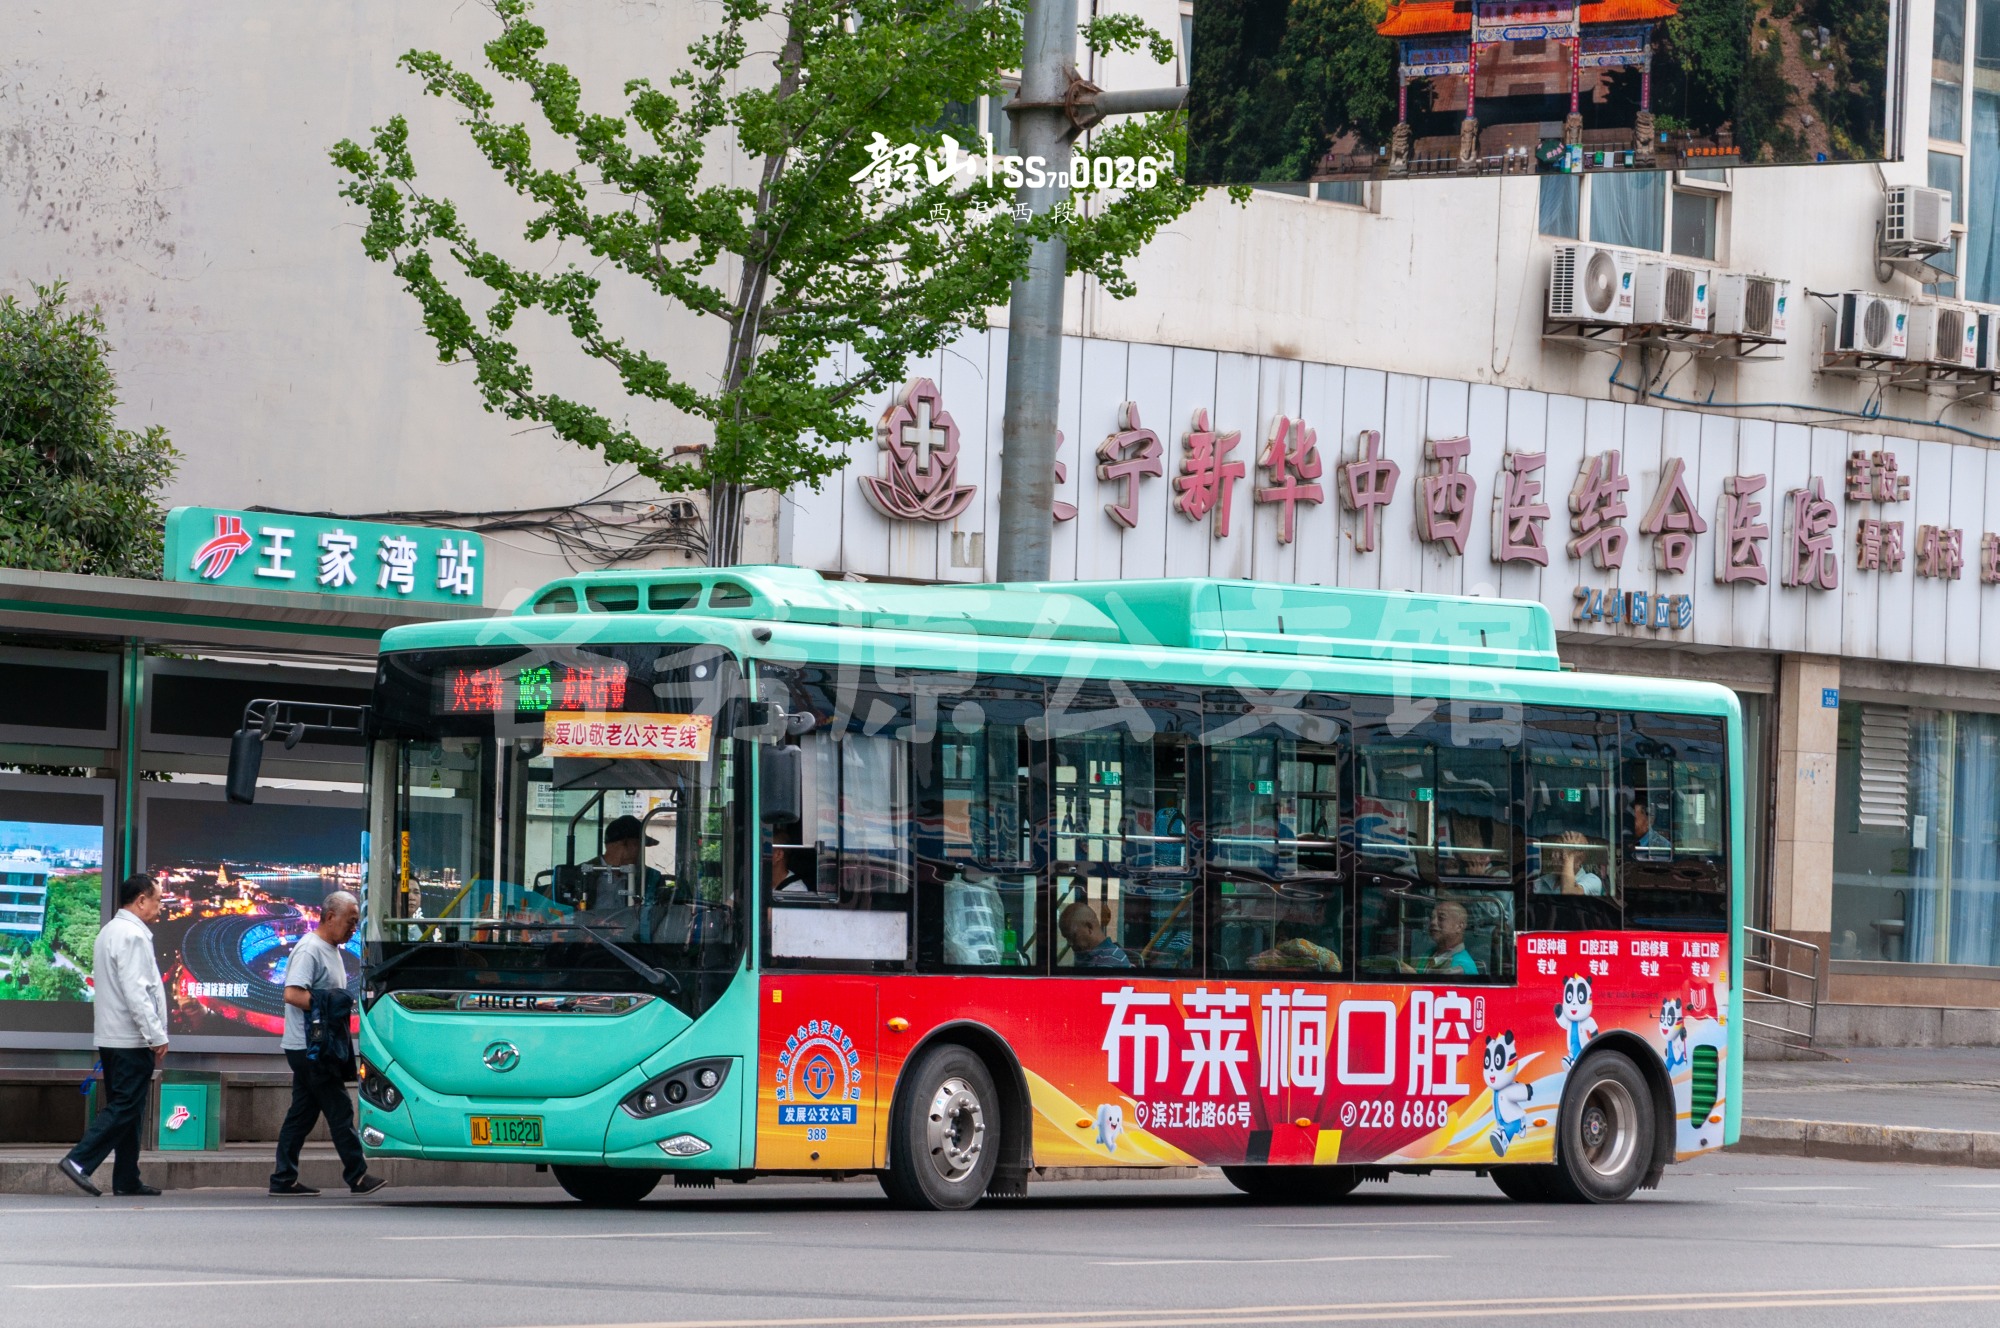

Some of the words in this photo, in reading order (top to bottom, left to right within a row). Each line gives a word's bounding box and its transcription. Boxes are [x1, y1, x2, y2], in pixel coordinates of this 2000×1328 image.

[1000, 400, 1839, 590] 宁新华中西医结合医院
[255, 526, 477, 596] 王家湾站
[1857, 519, 1906, 573] 骨科
[1916, 524, 1965, 581] 外科
[452, 669, 503, 711] 火车站
[554, 722, 697, 749] 爱心敬老公交专线
[1527, 938, 1567, 955] 口腔种植
[1579, 939, 1619, 957] 口腔正畸
[1631, 940, 1669, 958] 口腔修复
[1681, 941, 1720, 959] 儿童口腔
[1537, 958, 1557, 975] 专业
[1589, 959, 1609, 976] 专业
[1640, 960, 1660, 977] 专业
[1691, 961, 1711, 978] 专业
[478, 994, 538, 1010] HIGER
[1101, 986, 1472, 1096] 布莱梅口腔
[776, 1019, 861, 1101] 遂宁发展公共交通有限公司
[784, 1106, 852, 1123] 发展公交公司
[1152, 1100, 1252, 1129] 滨江北路66号
[1359, 1100, 1395, 1129] 228
[1401, 1100, 1449, 1129] 6868
[807, 1128, 827, 1141] 388
